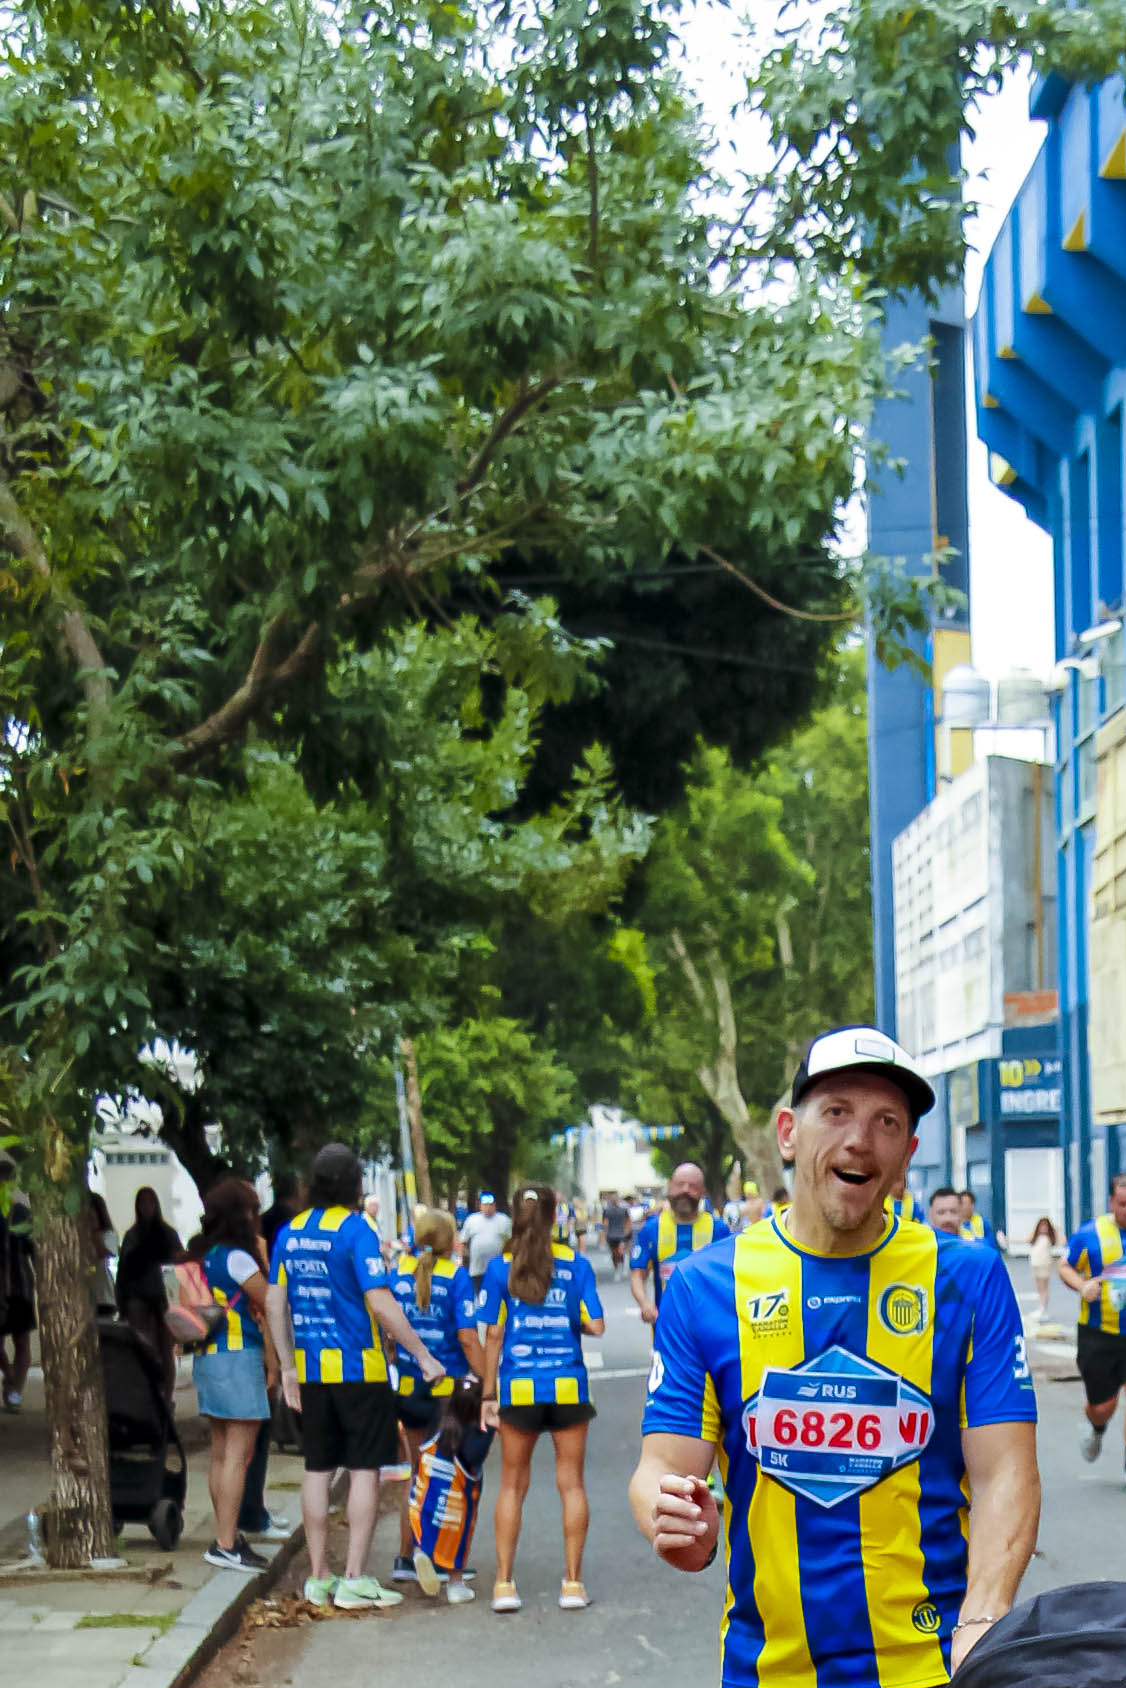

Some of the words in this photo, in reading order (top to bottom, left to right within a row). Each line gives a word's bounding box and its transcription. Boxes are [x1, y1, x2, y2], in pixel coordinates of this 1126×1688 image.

[748, 1291, 786, 1319] 17
[822, 1383, 857, 1399] RUS
[773, 1408, 882, 1450] 6826
[770, 1451, 788, 1467] 5K
